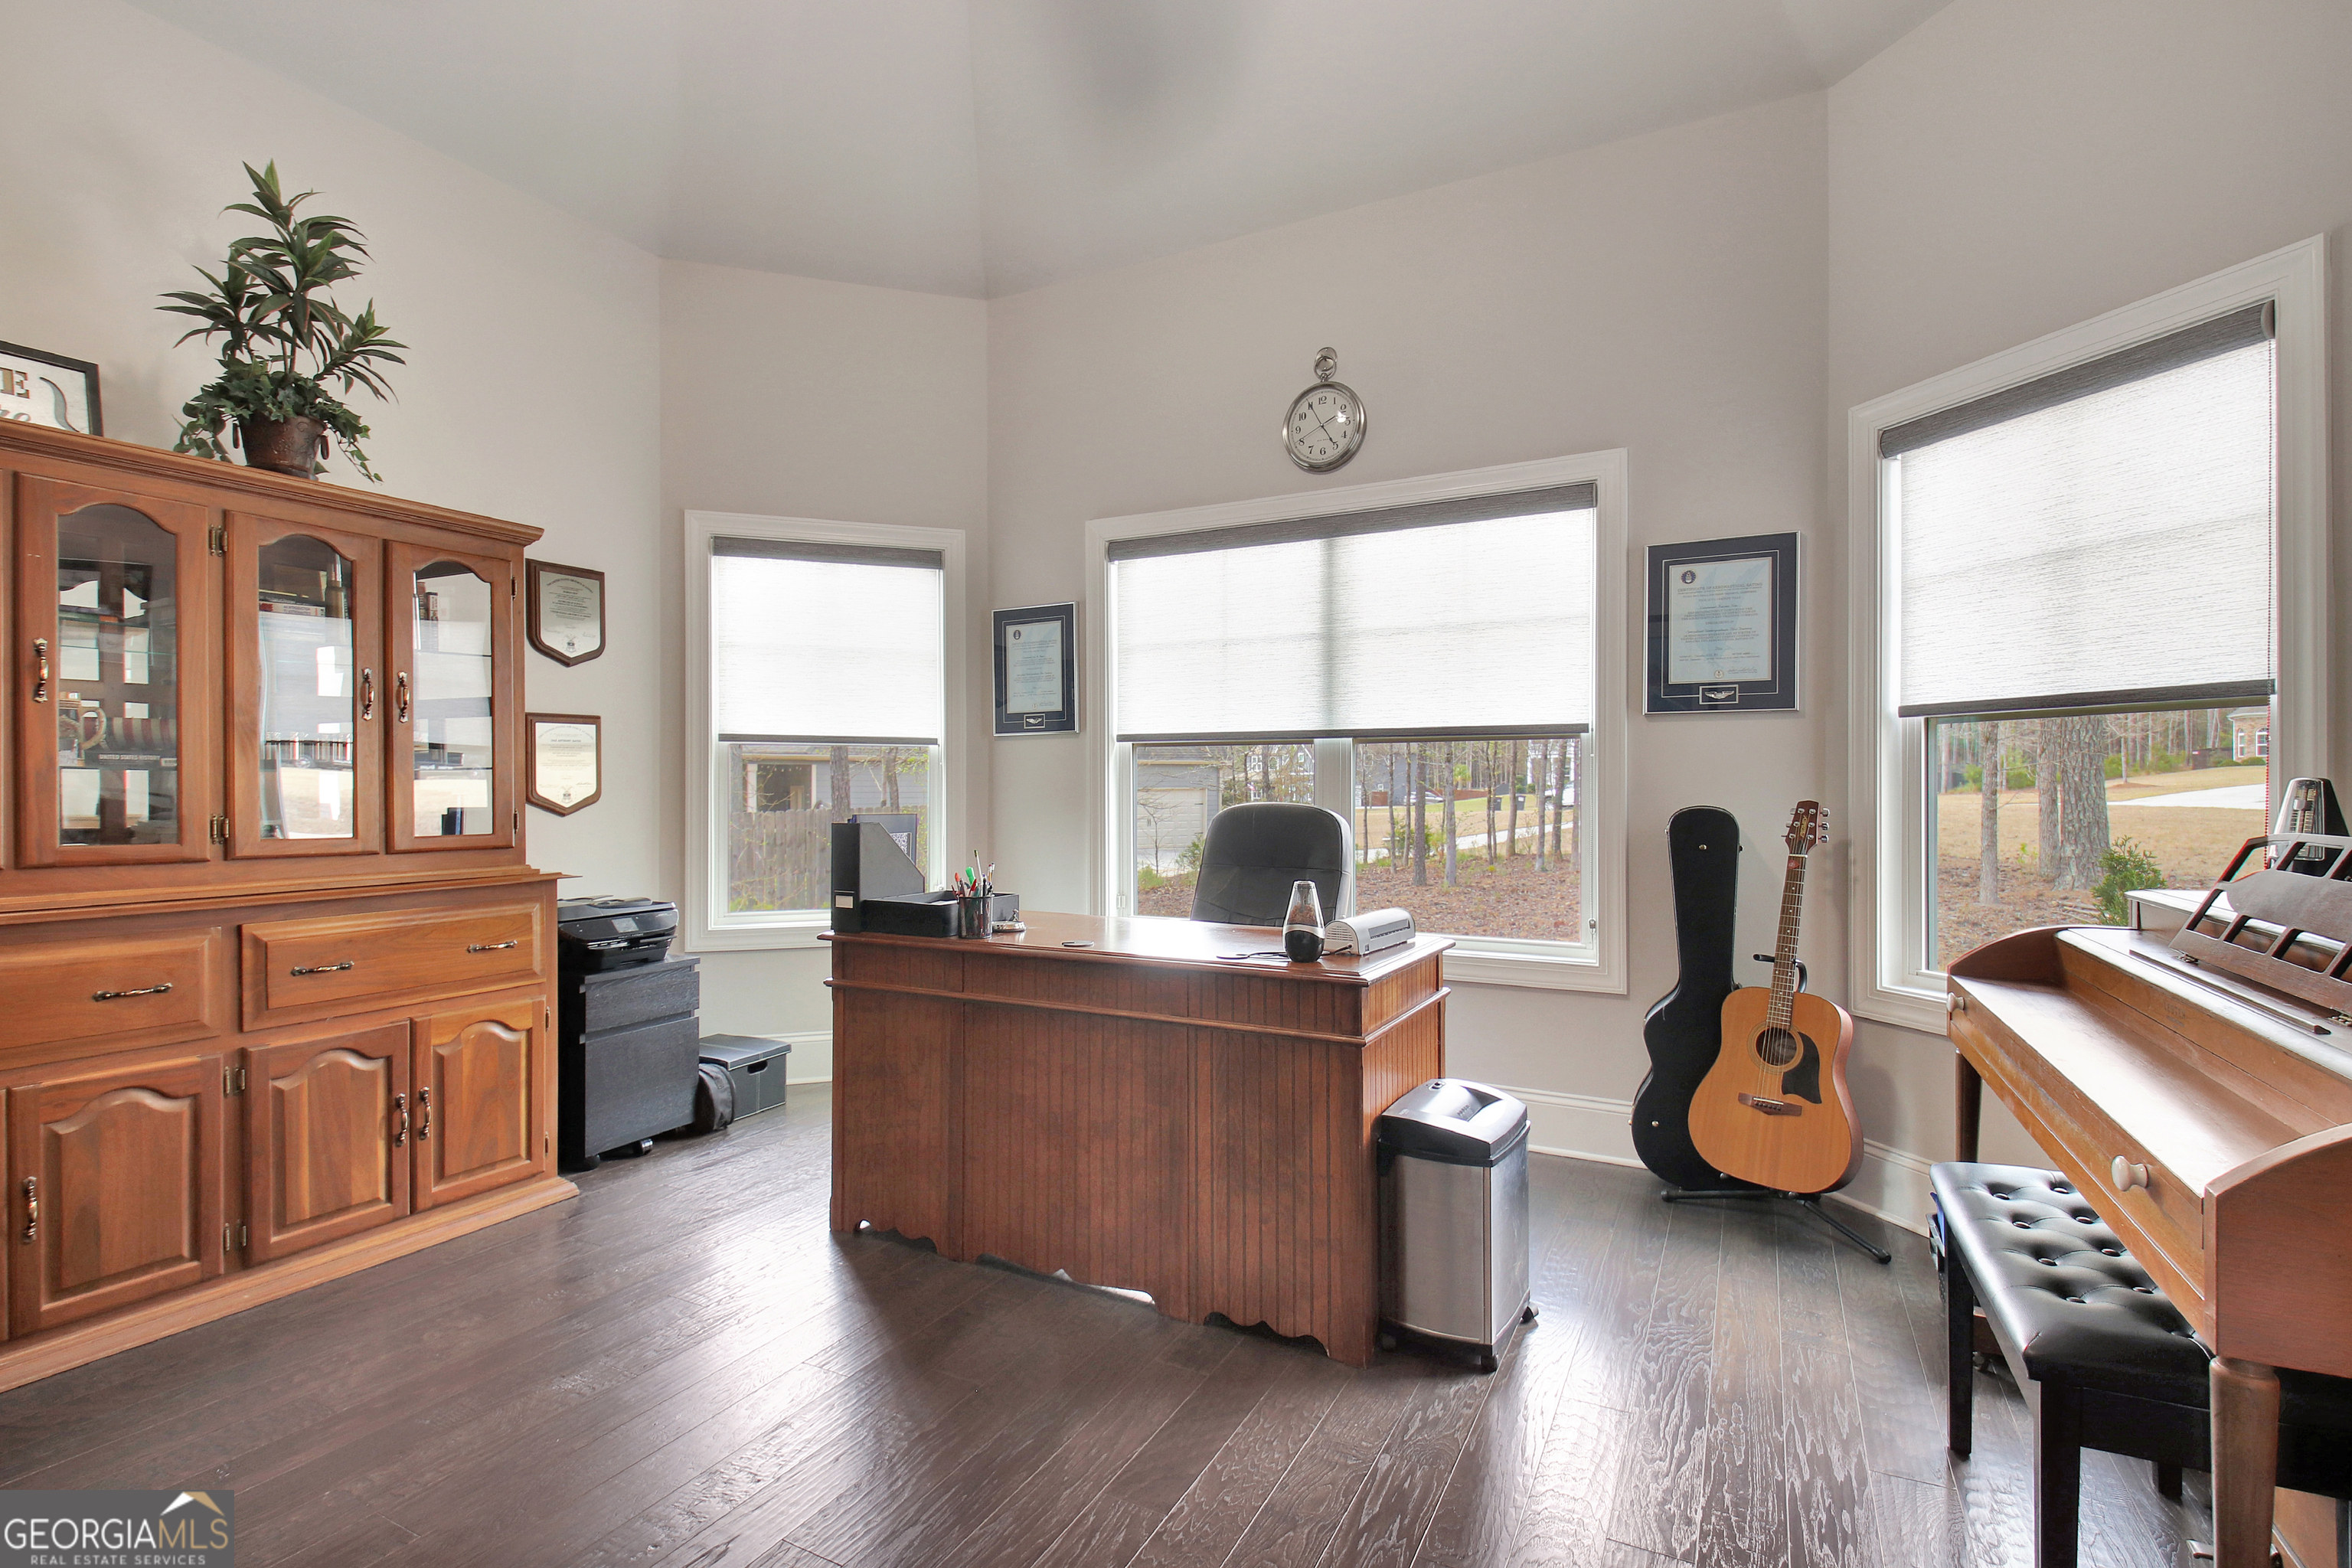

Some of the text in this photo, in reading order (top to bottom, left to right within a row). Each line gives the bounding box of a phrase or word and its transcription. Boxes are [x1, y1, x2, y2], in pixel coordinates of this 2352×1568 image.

[1318, 396, 1327, 405] 12
[1333, 397, 1336, 405] 1
[1298, 412, 1306, 421] 10
[1295, 426, 1301, 434] 9
[1341, 430, 1347, 439] 4
[1298, 437, 1305, 446] 8
[1332, 441, 1338, 450] 5
[1308, 445, 1314, 454] 7
[1319, 447, 1326, 456] 6
